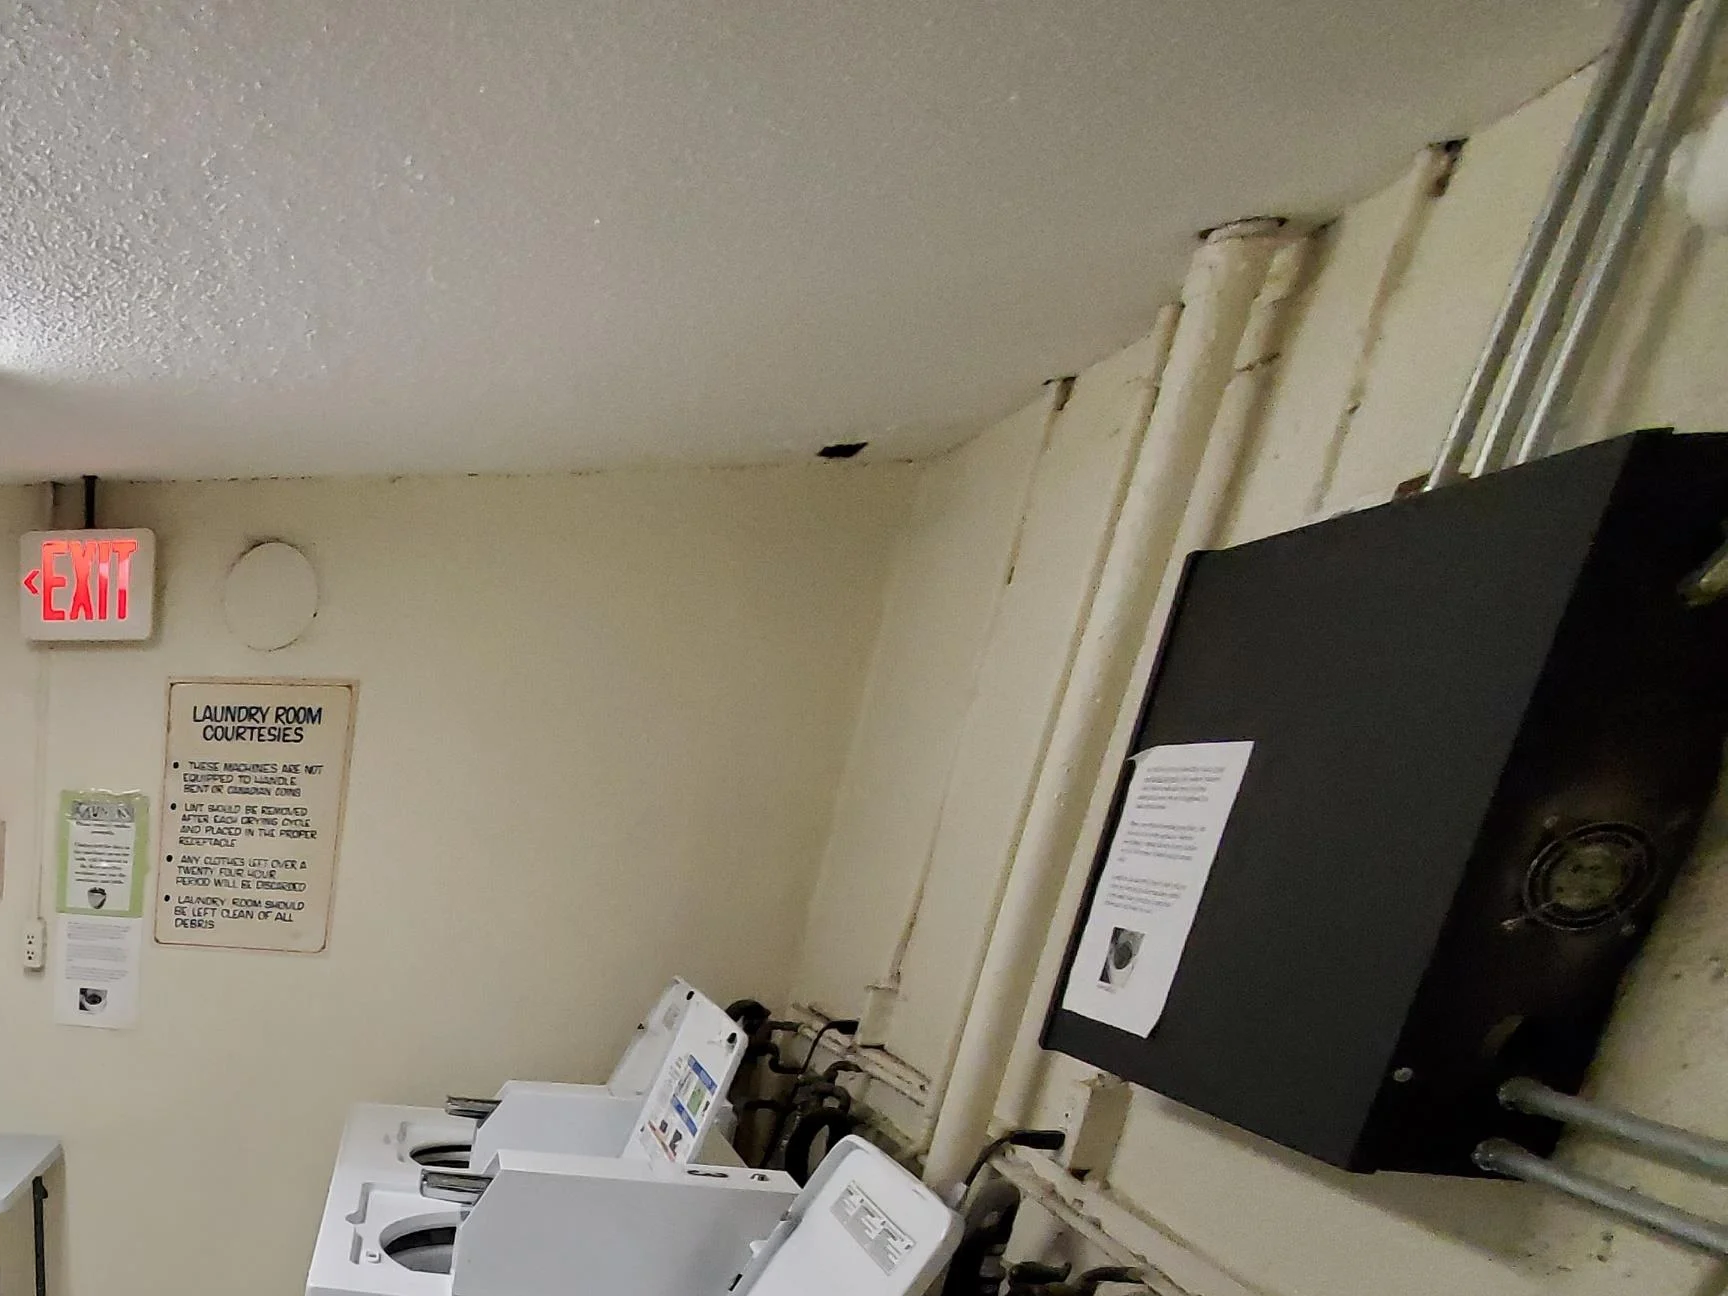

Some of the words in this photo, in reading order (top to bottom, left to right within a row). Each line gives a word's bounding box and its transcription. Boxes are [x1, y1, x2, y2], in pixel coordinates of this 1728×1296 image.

[42, 541, 138, 621] EXIT
[192, 705, 270, 724] LAUNDRY
[275, 706, 322, 725] ROOM
[203, 725, 304, 742] COURTESIES
[189, 761, 219, 772] THESE
[223, 762, 278, 773] MACHINES
[282, 764, 301, 774] ARE
[305, 765, 324, 775] NOT
[183, 773, 233, 783] EQUIPPED
[238, 775, 251, 784] TO
[254, 775, 296, 786] HANDLE
[184, 785, 209, 794] BENT
[211, 785, 223, 794] OR
[275, 788, 301, 797] COINS
[185, 803, 204, 812] LINT
[208, 804, 241, 814] SHOULD
[245, 806, 258, 815] BE
[261, 806, 308, 816] REMOVED
[181, 814, 209, 824] AFTER
[214, 815, 237, 824] EACH
[241, 816, 278, 826] DRYING
[282, 818, 310, 828] CYCLE
[180, 825, 201, 834] AND
[205, 826, 241, 836] PLACED
[245, 828, 254, 837] IN
[258, 829, 276, 838] THE
[279, 830, 317, 840] PROPER
[181, 855, 201, 865] ANY
[204, 857, 245, 866] CLOTHES
[249, 858, 269, 867] LEFT
[271, 860, 297, 869] OVER
[300, 861, 307, 869] A
[177, 866, 214, 876] TWENTY
[220, 868, 244, 878] FOUR
[248, 870, 276, 879] HOUR
[176, 877, 210, 886] PERIOD
[214, 878, 237, 888] WILL
[241, 880, 252, 889] BE
[178, 896, 225, 907] LAUNDRY
[232, 898, 262, 908] ROOM
[265, 900, 305, 910] SHOULD
[174, 906, 187, 916] BE
[192, 907, 217, 918] LEFT
[221, 909, 254, 920] CLEAN
[258, 911, 273, 920] OF
[274, 912, 293, 922] ALL
[174, 918, 215, 929] DEBRIS
[687, 1169, 729, 1178] 3
